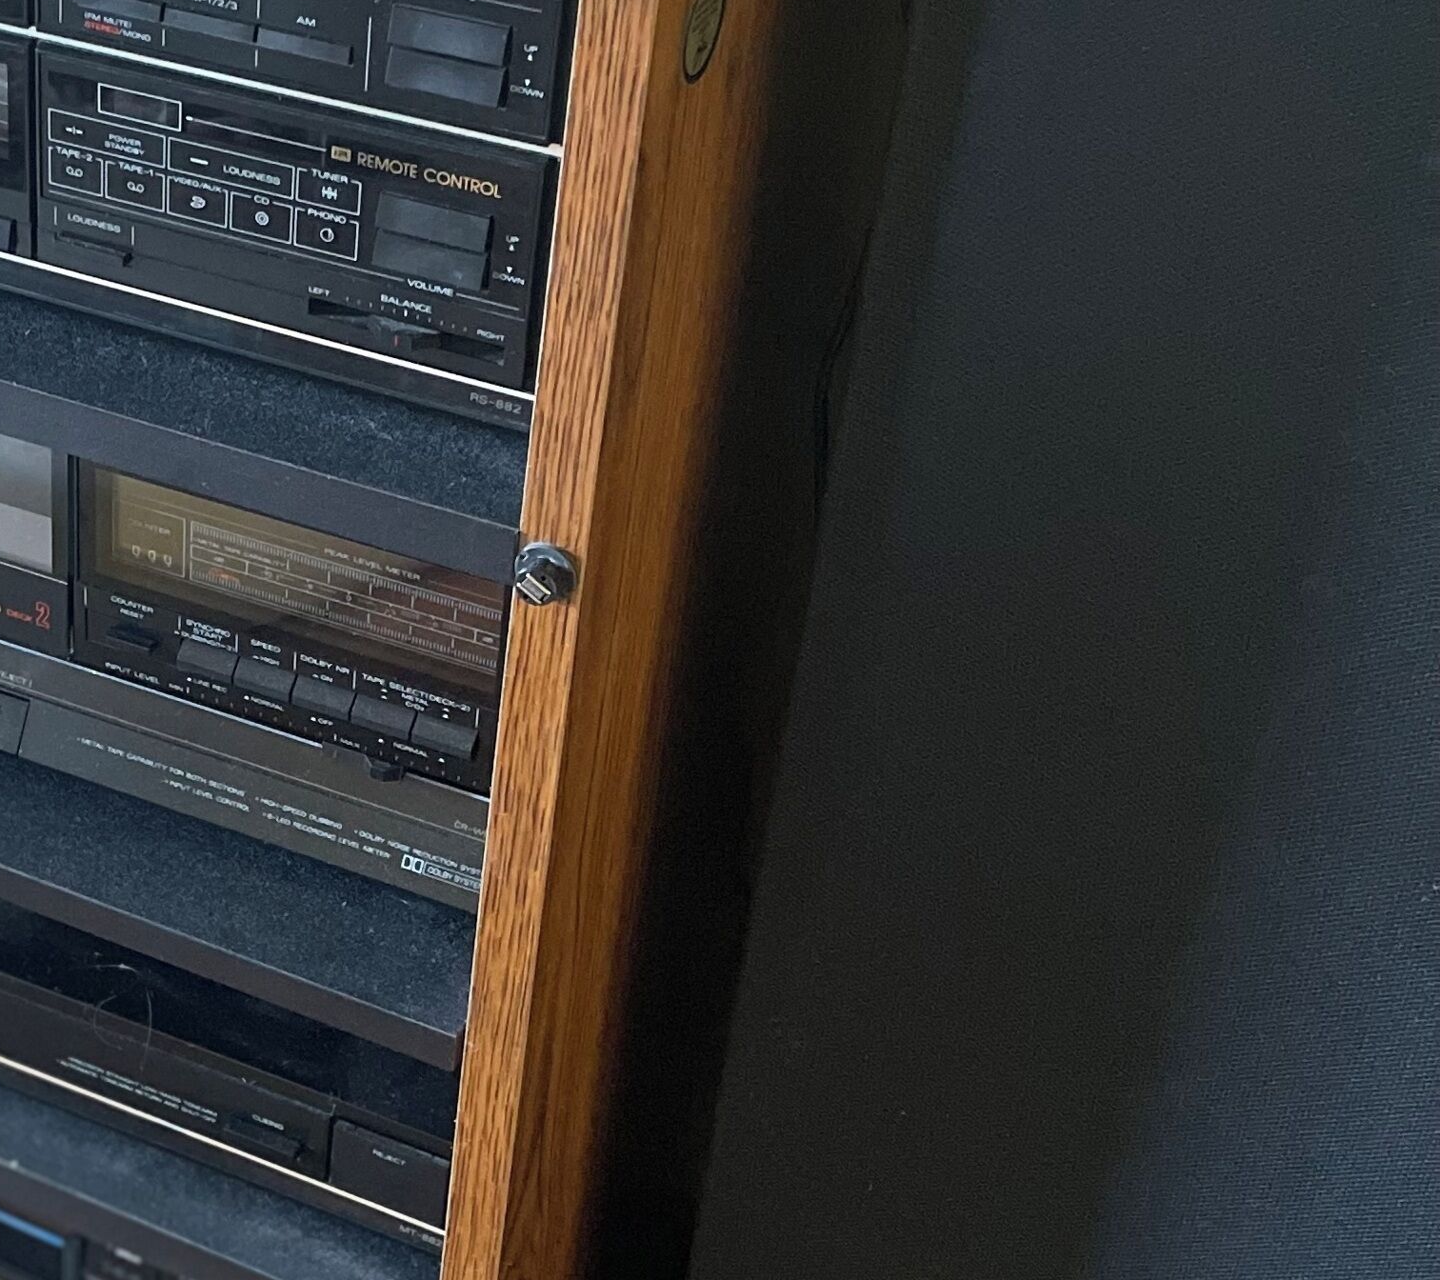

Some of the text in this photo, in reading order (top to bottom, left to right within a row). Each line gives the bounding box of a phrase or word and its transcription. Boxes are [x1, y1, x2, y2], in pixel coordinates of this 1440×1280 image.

[296, 14, 317, 28] AM
[83, 19, 153, 44] STEREO/MONO
[523, 42, 540, 53] UP
[509, 83, 545, 100] DOWN
[104, 140, 146, 158] STANDBY
[108, 132, 143, 148] POWER
[56, 145, 94, 164] TAPE-2
[117, 160, 155, 177] TAPE-1
[222, 163, 282, 187] LOUDNESS
[310, 167, 350, 185] TUNER
[356, 151, 419, 179] REMOTE
[423, 167, 503, 200] CONTROL
[172, 174, 225, 194] VIDEO/AUX
[253, 194, 271, 207] CD
[66, 211, 122, 235] LOUDNESS
[307, 207, 348, 225] PHONO
[505, 234, 520, 245] UP
[406, 277, 456, 298] VOLUME
[491, 271, 527, 287] DOWN
[308, 285, 330, 298] LEFT
[379, 292, 433, 315] BALANCE
[476, 327, 506, 343] RIGHT
[469, 391, 523, 416] RS-882
[323, 546, 422, 581] PEAK LEVEL METER
[110, 595, 155, 615] COUNTER
[5, 607, 33, 623] DECK
[34, 600, 51, 631] 2
[193, 626, 224, 642] START
[105, 661, 161, 685] INPUT LEVEL
[299, 653, 351, 675] DOLBY NR
[320, 673, 334, 684] ON
[361, 672, 386, 686] TAPE
[250, 695, 286, 712] NORMAL
[401, 692, 430, 707] METAL
[392, 741, 429, 759] NORMAL
[454, 819, 487, 837] CR-W
[426, 865, 482, 890] DOLBY SYSTE
[371, 1148, 407, 1167] REJECT
